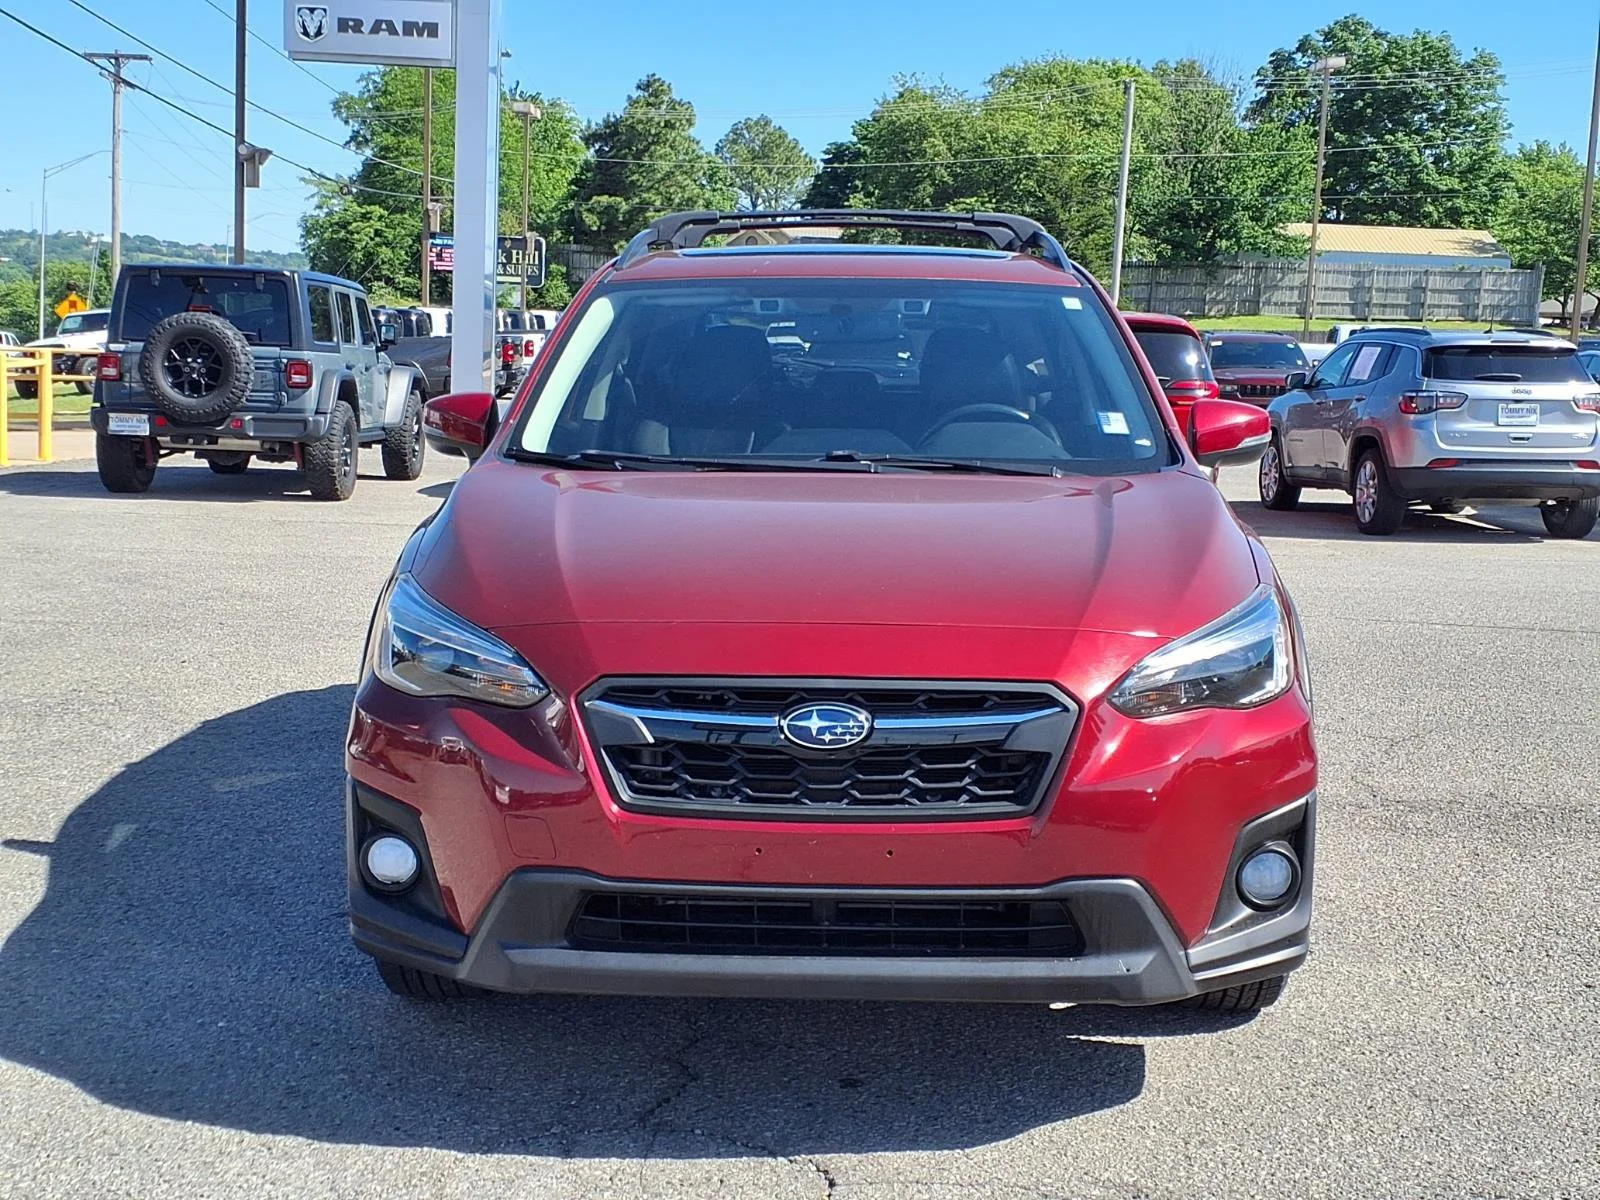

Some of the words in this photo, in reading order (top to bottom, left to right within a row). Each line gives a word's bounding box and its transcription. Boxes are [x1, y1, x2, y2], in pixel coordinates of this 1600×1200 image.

[337, 16, 439, 39] RAM
[505, 264, 539, 276] SUIES
[1501, 406, 1525, 415] TOMMY
[1525, 406, 1538, 415] NIX
[110, 415, 134, 423] TOMMY
